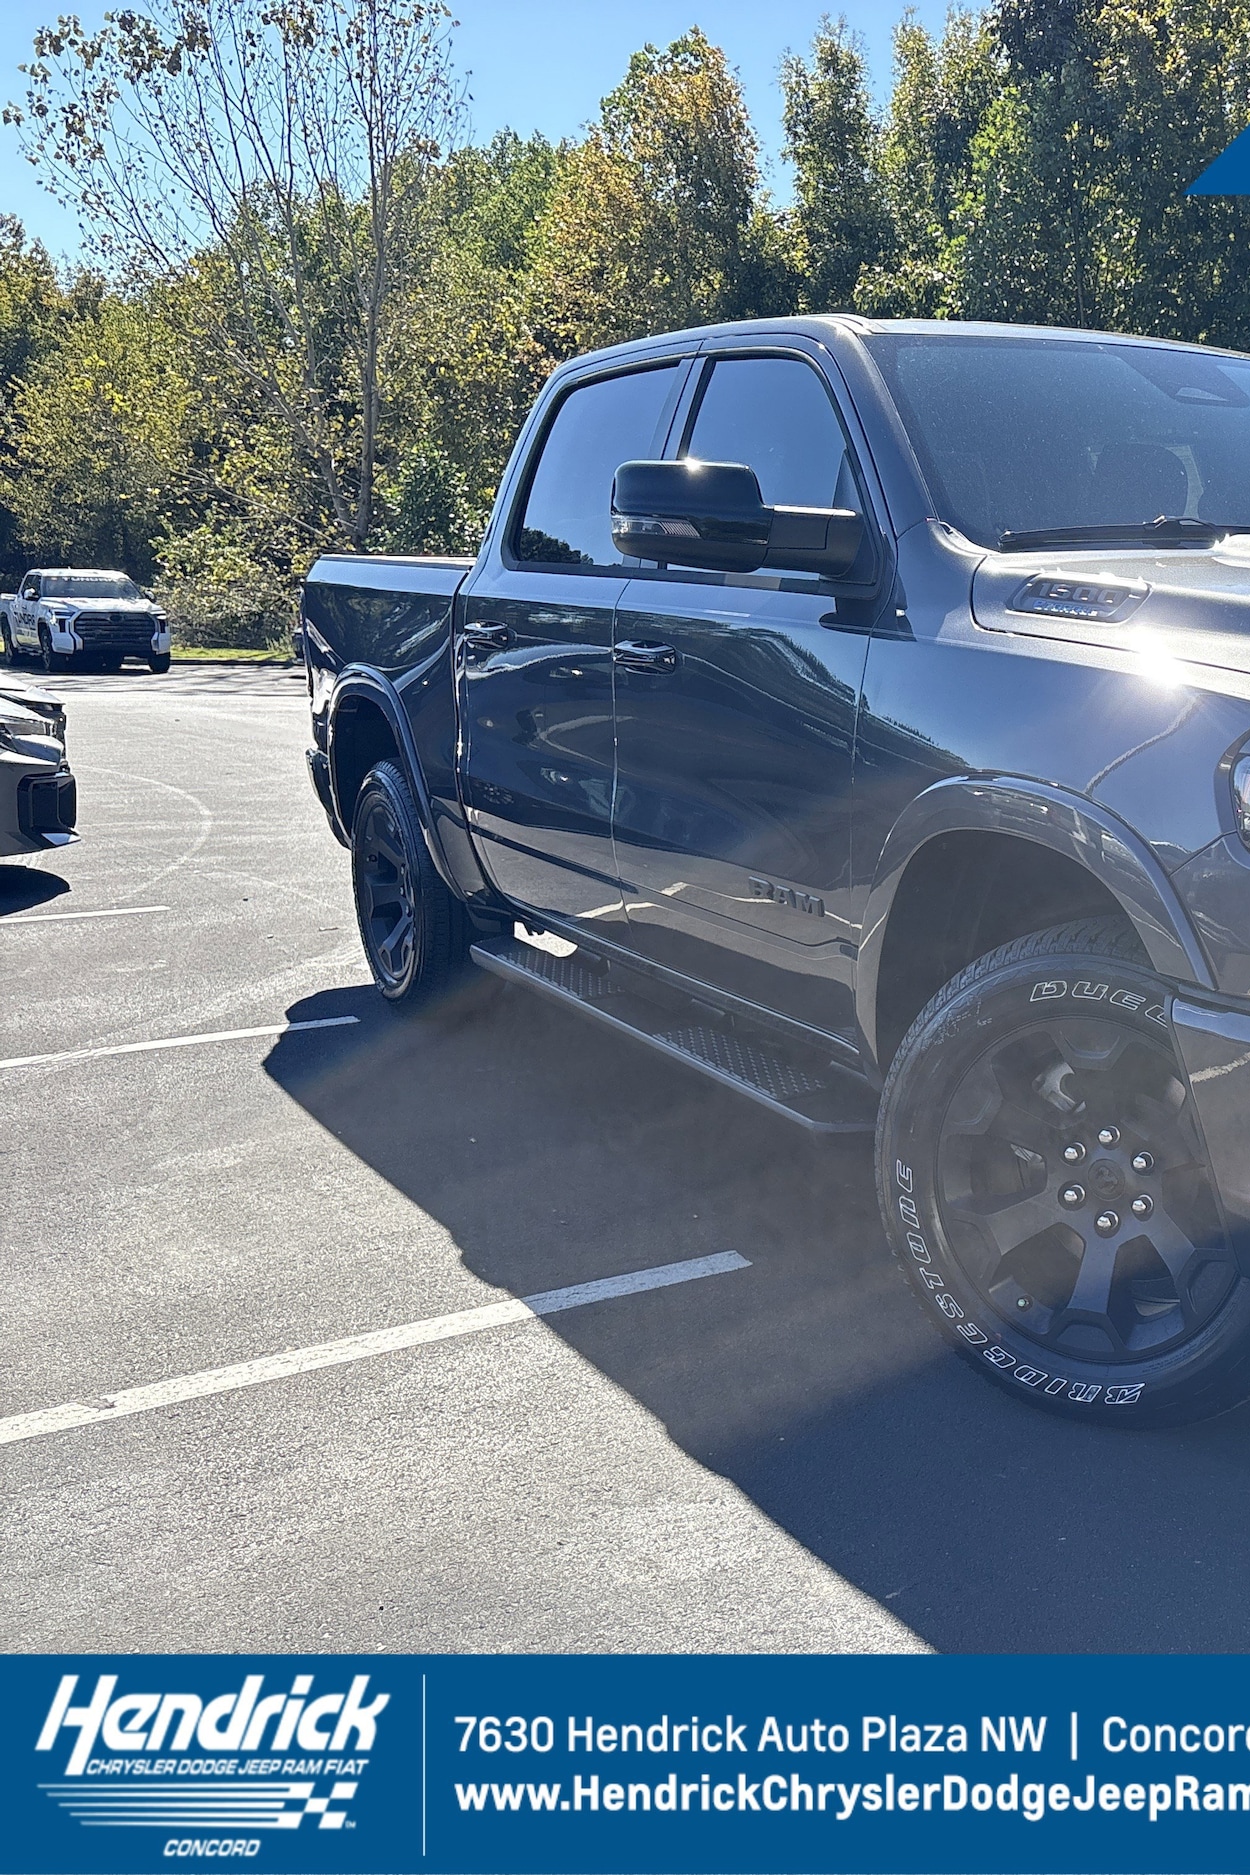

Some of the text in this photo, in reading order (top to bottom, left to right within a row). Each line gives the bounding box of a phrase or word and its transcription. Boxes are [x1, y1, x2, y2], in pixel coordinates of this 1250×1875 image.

[1039, 582, 1124, 604] 1500
[748, 876, 825, 917] RAM
[895, 1158, 1147, 1405] BRIDGESTONE
